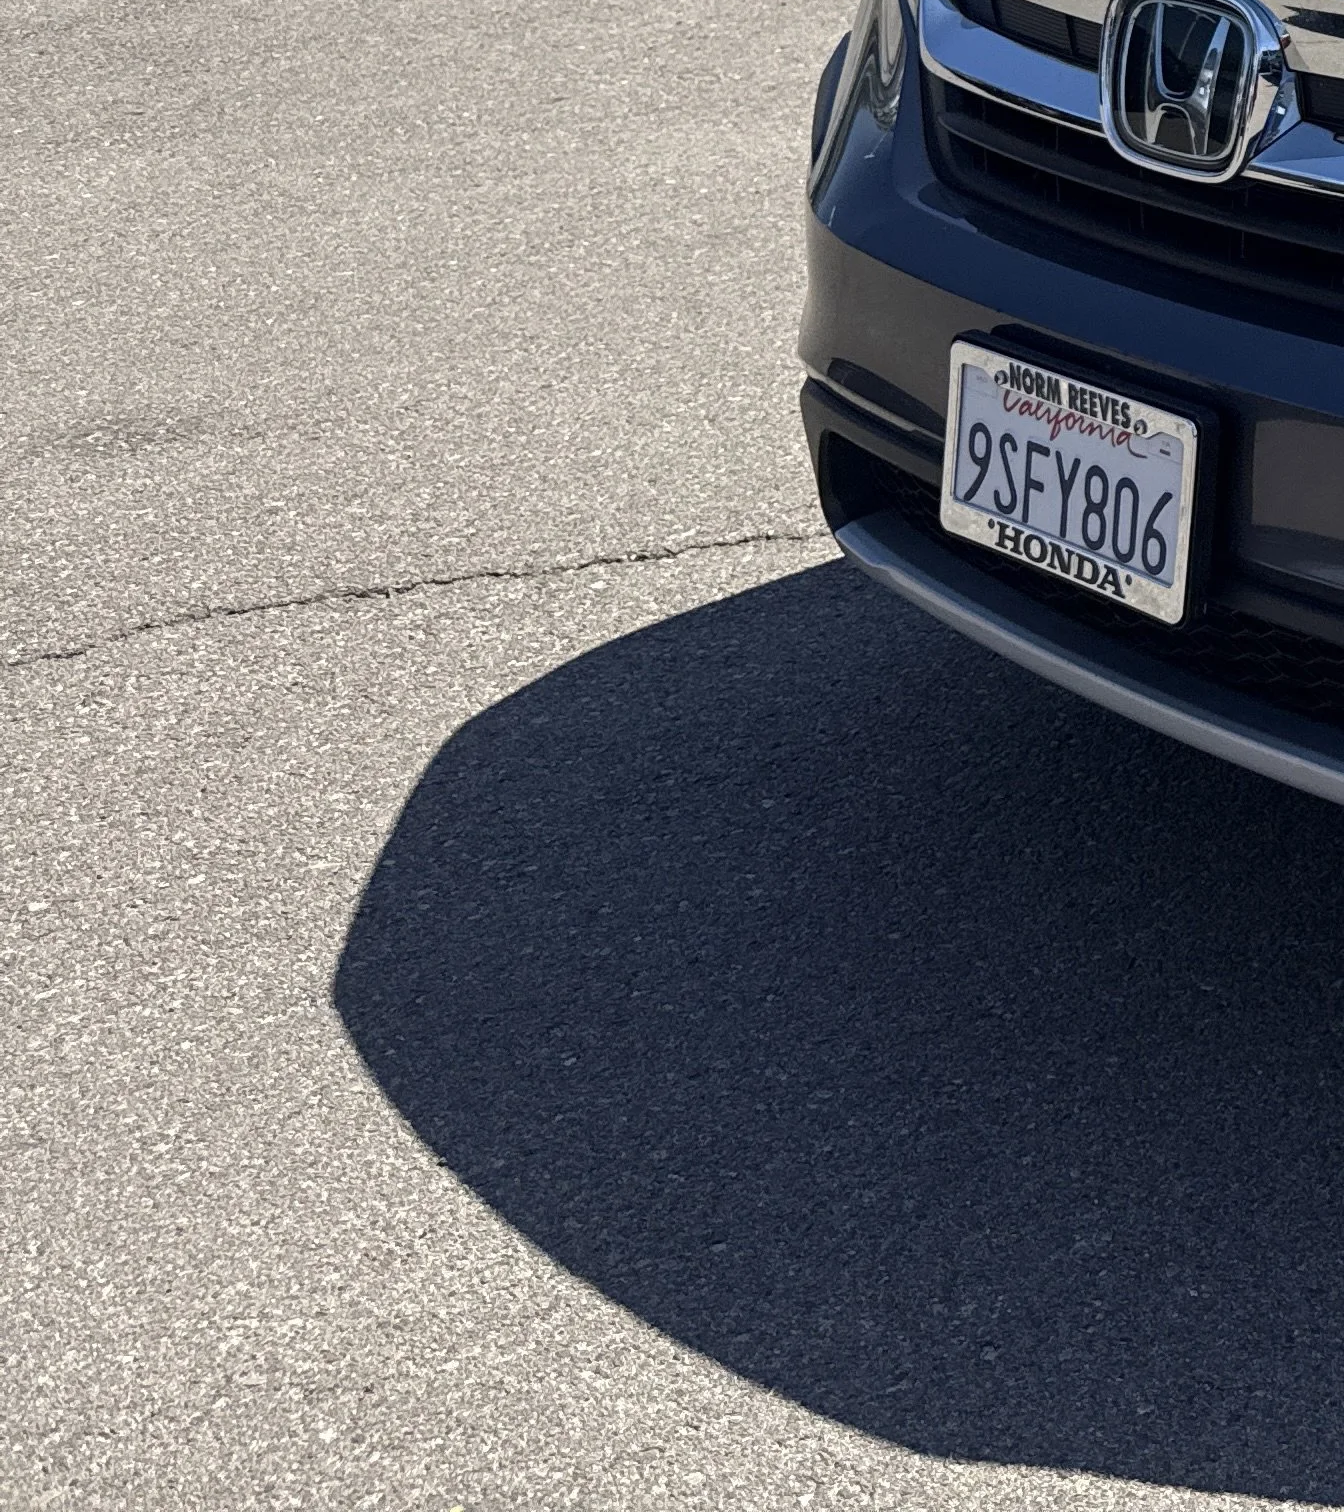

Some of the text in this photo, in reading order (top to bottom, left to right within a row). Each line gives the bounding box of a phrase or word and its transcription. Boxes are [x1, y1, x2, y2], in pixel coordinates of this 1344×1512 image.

[1009, 362, 1131, 429] NORM REEVES
[963, 422, 1174, 576] 9SFY806
[995, 521, 1126, 599] HONDA
